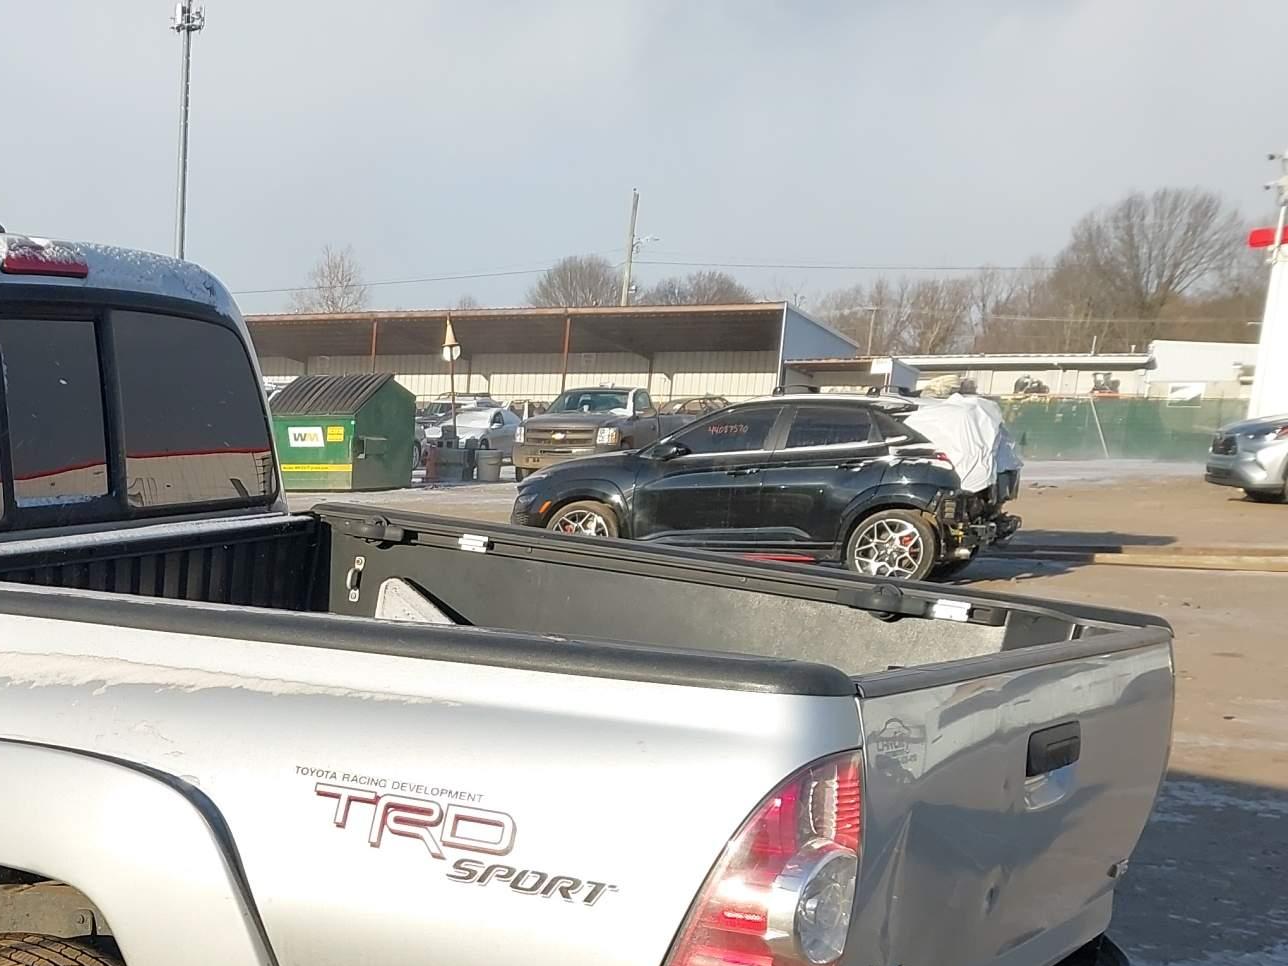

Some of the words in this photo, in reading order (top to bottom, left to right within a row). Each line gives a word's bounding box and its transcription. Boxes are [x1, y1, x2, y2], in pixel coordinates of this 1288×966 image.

[295, 765, 337, 781] TOYOTA
[342, 773, 387, 788] RACING
[392, 781, 485, 802] DEVELOPMENT
[314, 782, 517, 860] TRD
[445, 858, 612, 907] SPORT
